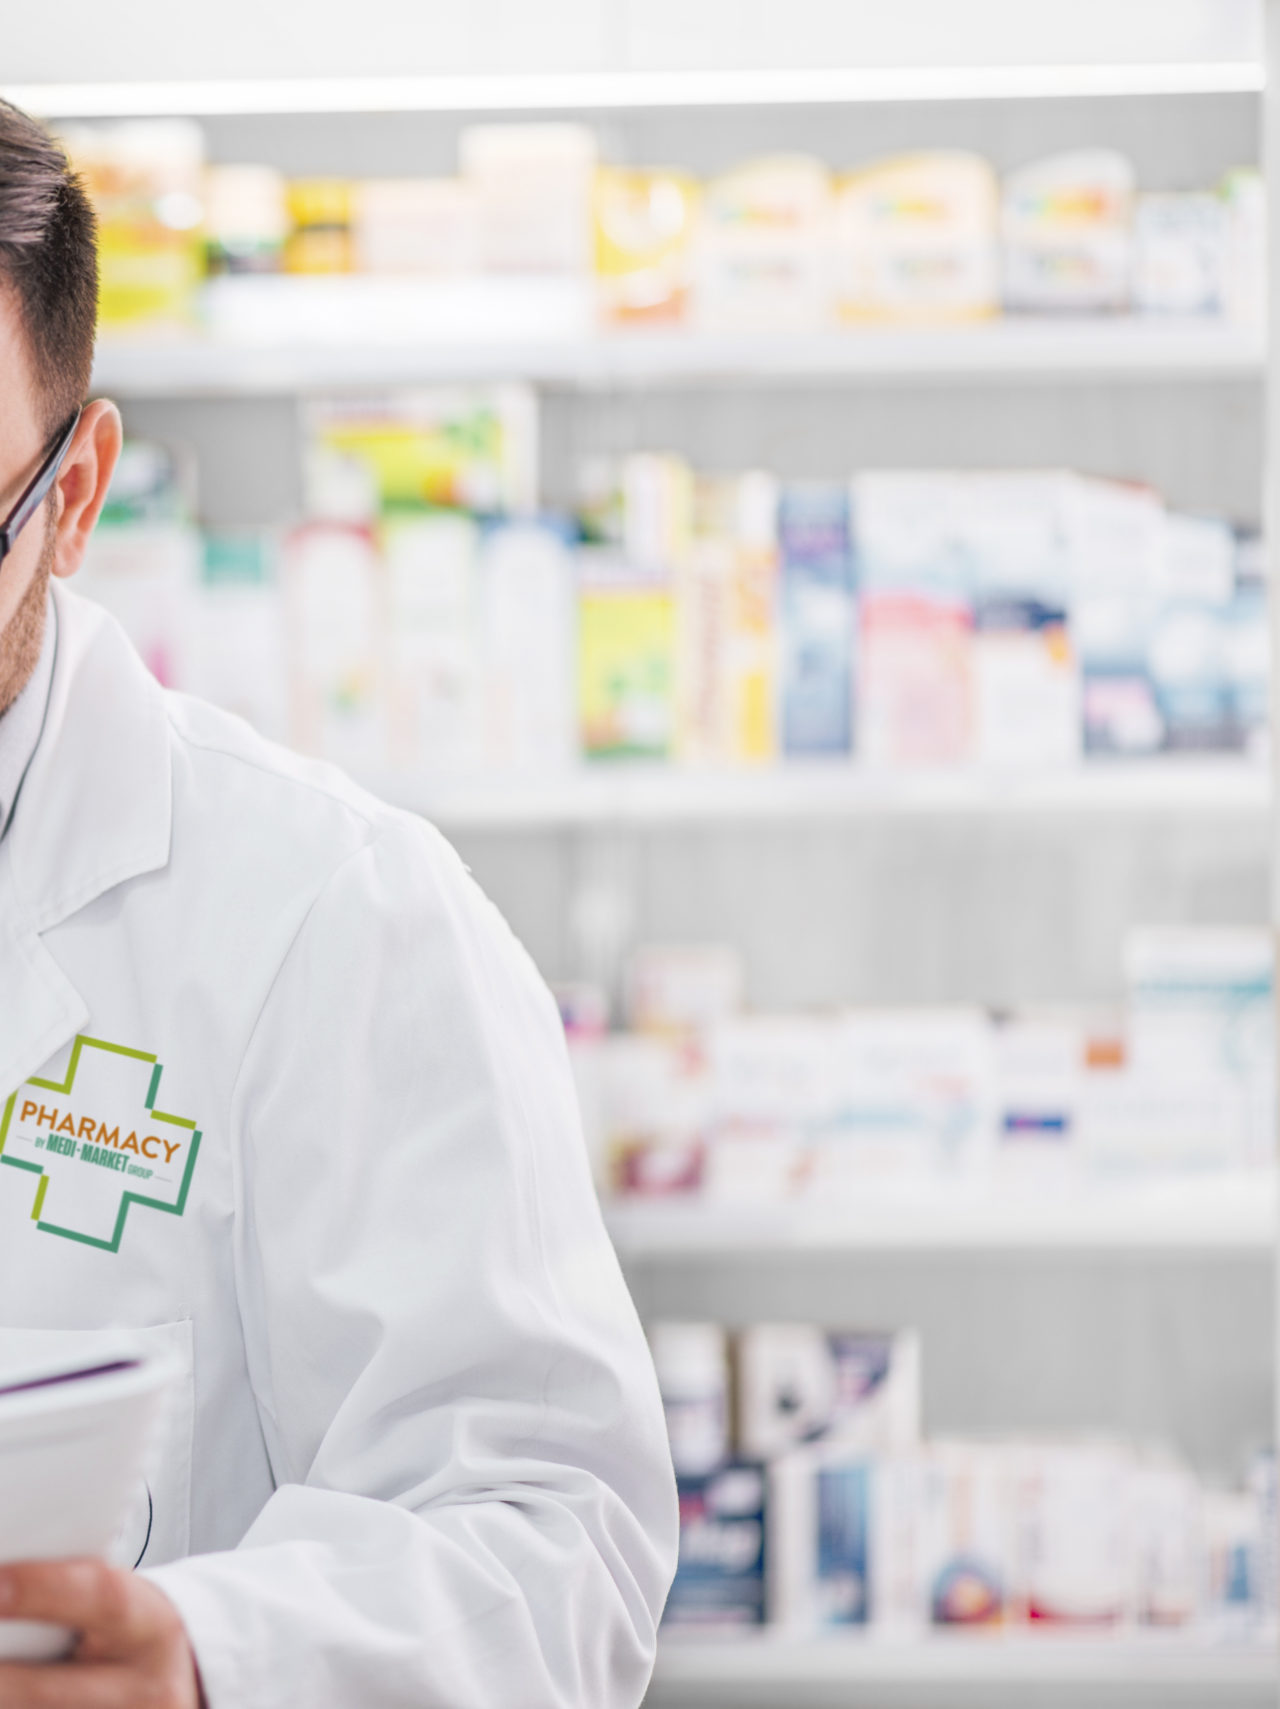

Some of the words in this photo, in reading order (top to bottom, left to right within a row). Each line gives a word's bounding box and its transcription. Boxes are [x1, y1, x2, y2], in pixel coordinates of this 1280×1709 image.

[20, 1100, 181, 1163] PHARMACY
[35, 1137, 46, 1148] BY
[127, 1164, 153, 1179] GROUP
